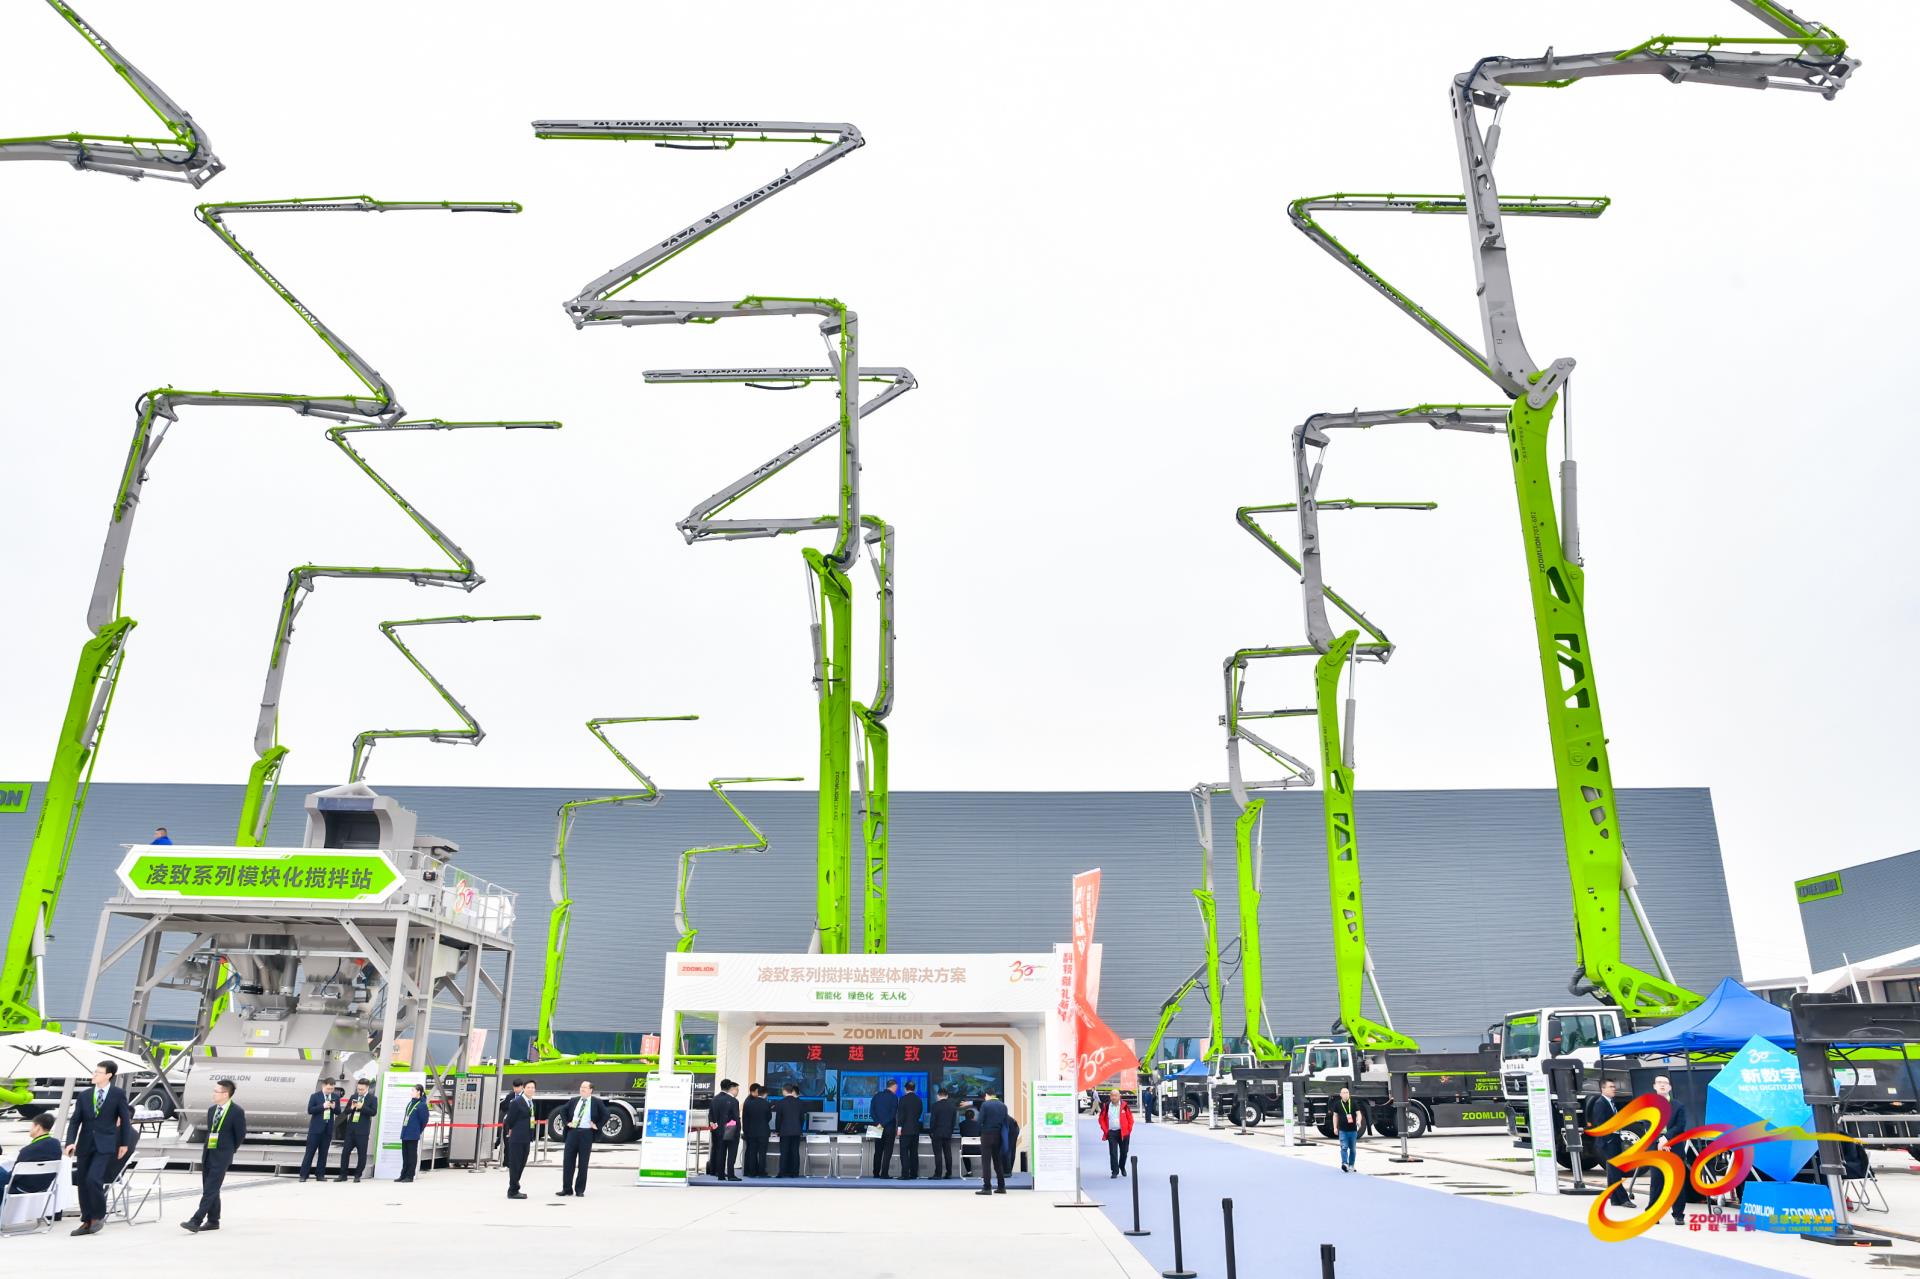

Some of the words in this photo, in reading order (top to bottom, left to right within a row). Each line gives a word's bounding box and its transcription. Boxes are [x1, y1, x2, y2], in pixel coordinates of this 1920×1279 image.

[146, 863, 373, 890] 凌致系列模块化搅拌站
[757, 966, 967, 984] 凌致系列搅拌站整体解决方案
[816, 991, 842, 1001] 智能化
[848, 991, 874, 1001] 绿色化
[880, 991, 907, 1001] 无人化
[843, 1028, 924, 1040] ZOOMLION
[209, 1074, 251, 1082] ZOOMLION
[1462, 1111, 1506, 1120] ZOOMLIO
[1744, 1203, 1775, 1216] ZOOMLION
